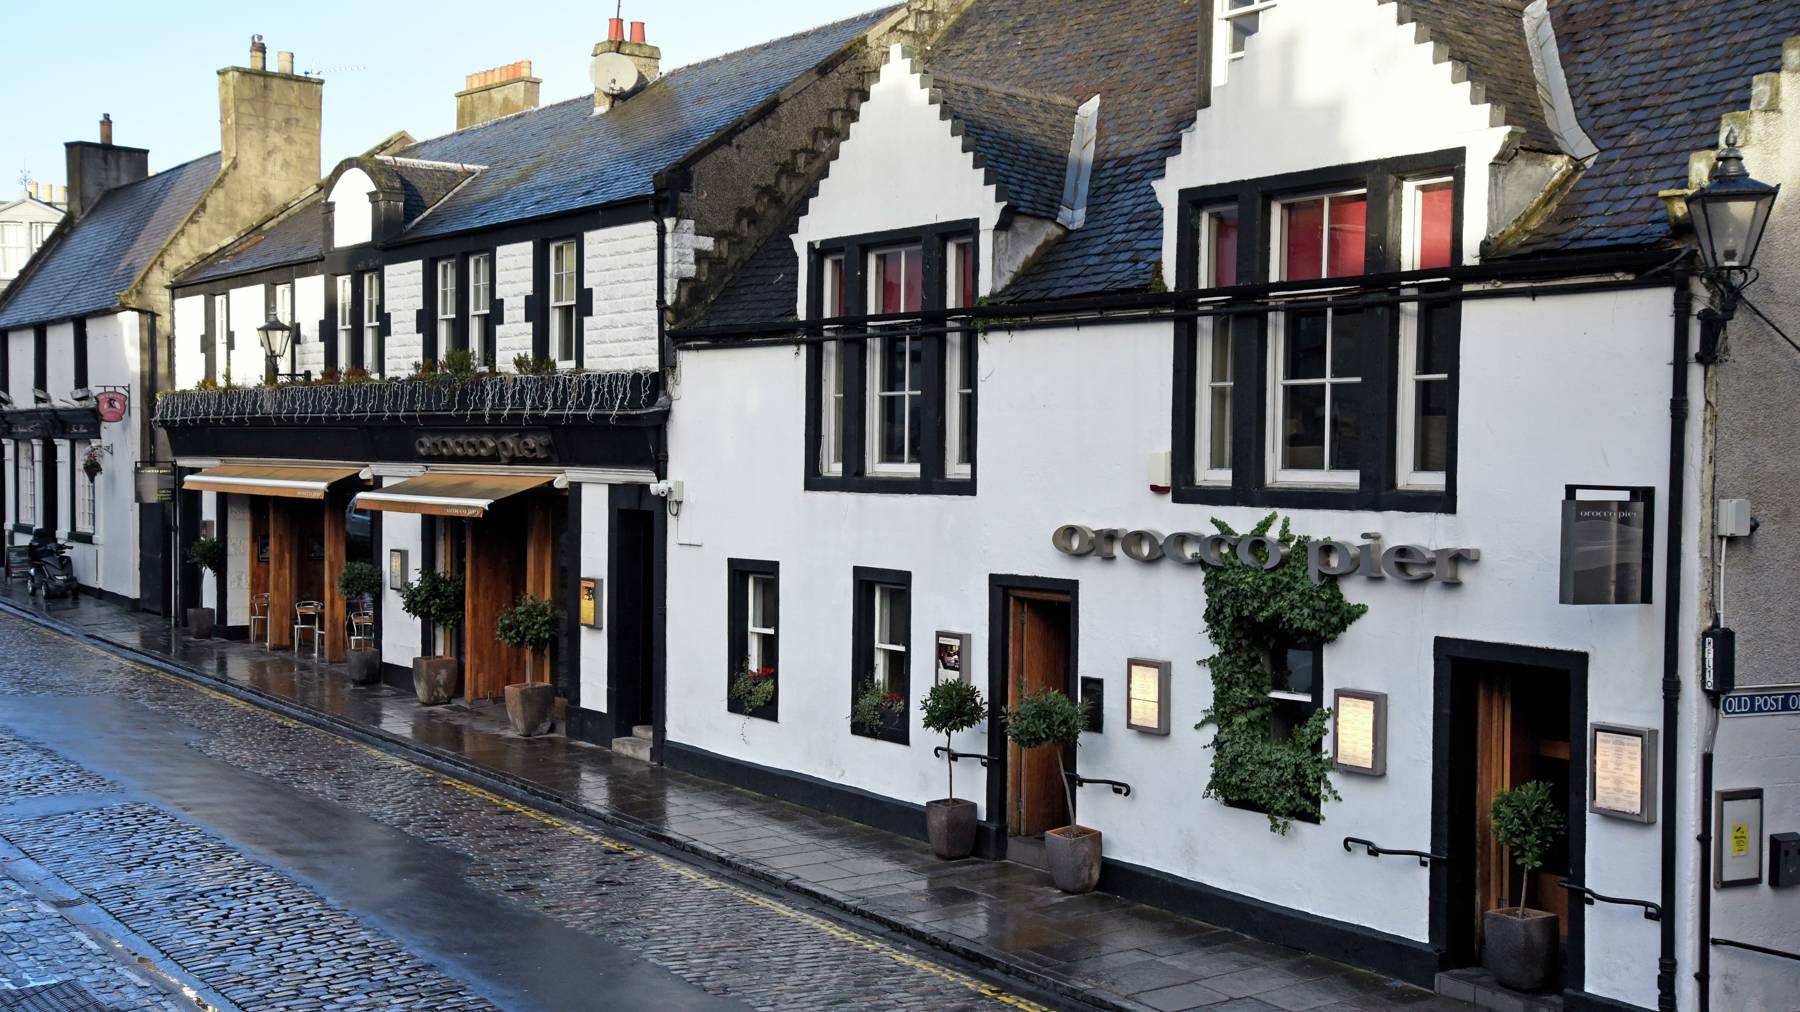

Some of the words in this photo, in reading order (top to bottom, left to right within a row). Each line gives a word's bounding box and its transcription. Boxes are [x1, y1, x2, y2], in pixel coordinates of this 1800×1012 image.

[415, 436, 497, 456] orocco
[499, 433, 549, 463] pier
[1052, 524, 1290, 570] orocco
[1306, 532, 1480, 584] pier
[1726, 697, 1750, 713] OLD
[1755, 695, 1785, 711] POST
[1789, 694, 1800, 710] O
